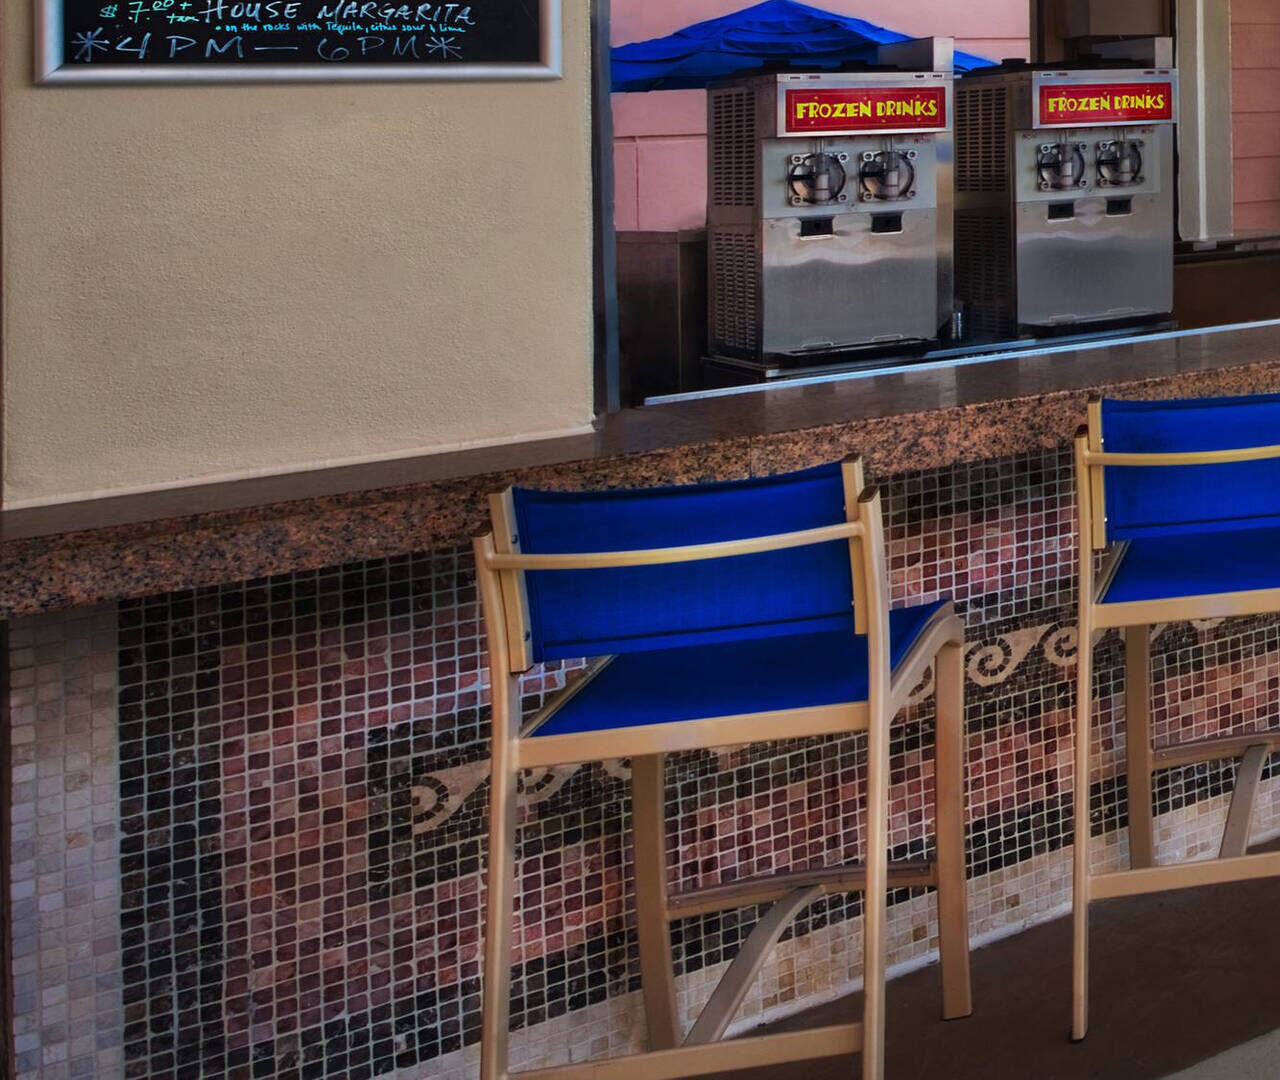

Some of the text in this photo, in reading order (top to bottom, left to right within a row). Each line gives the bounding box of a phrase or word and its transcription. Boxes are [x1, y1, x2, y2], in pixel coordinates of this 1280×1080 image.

[317, 0, 476, 26] MARGARITA
[796, 99, 938, 119] FROZEN DRINKS
[1048, 93, 1165, 112] FROZEN DRINKS
